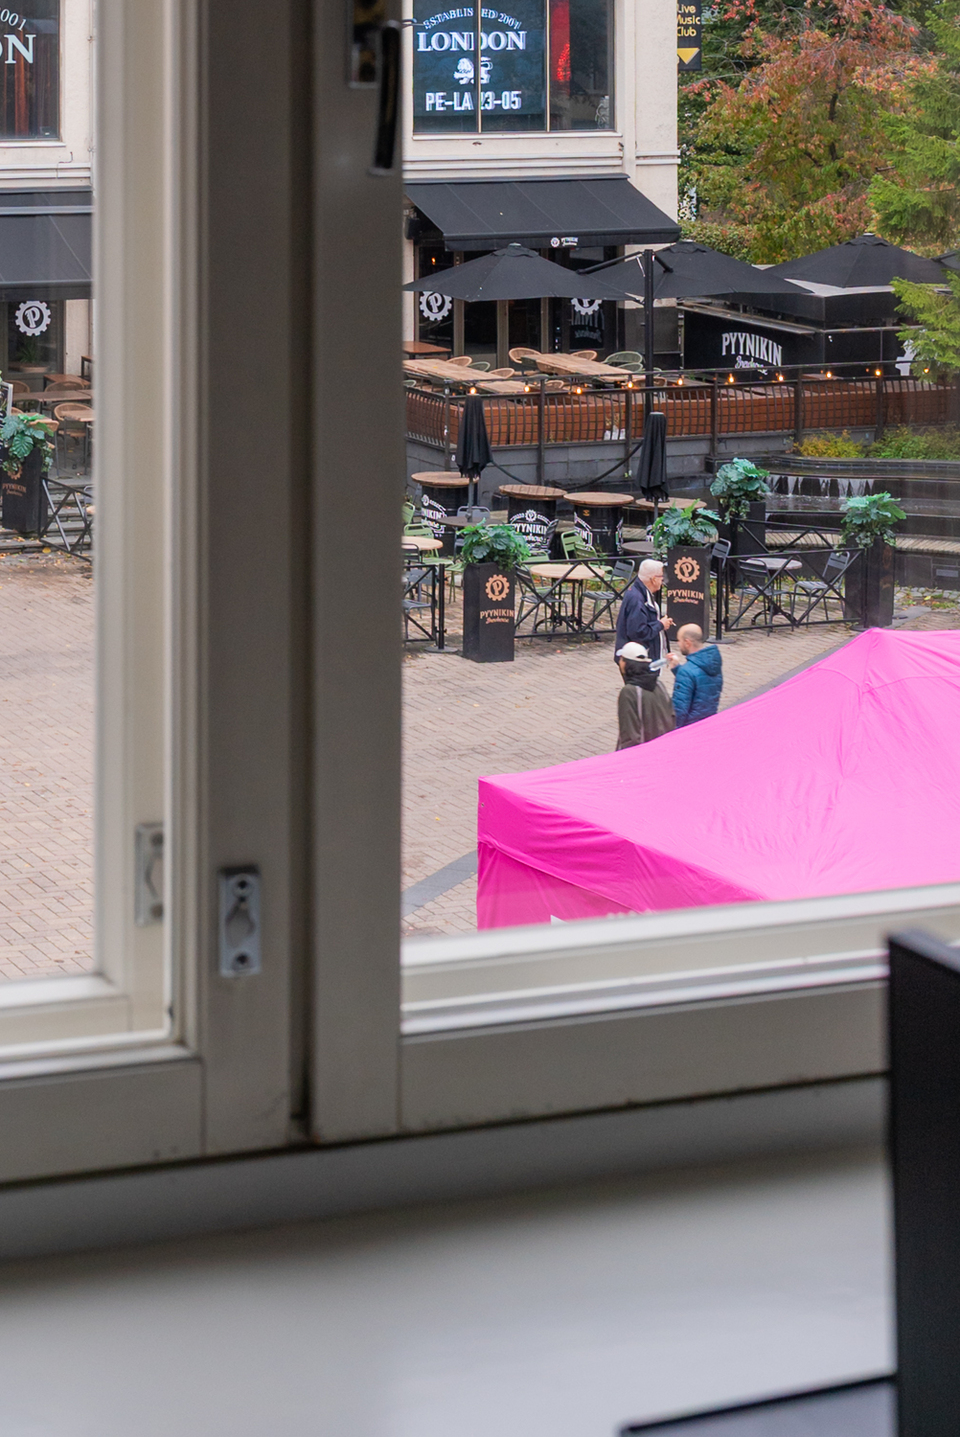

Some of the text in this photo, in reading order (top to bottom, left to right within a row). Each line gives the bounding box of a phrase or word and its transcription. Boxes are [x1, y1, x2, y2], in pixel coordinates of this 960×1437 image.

[423, 7, 498, 30] ESTABLISED
[425, 91, 474, 112] PE-LA
[721, 332, 782, 367] PYYNIKIN
[668, 589, 704, 600] PYYNIKIN
[480, 608, 515, 619] PYYNIKIN
